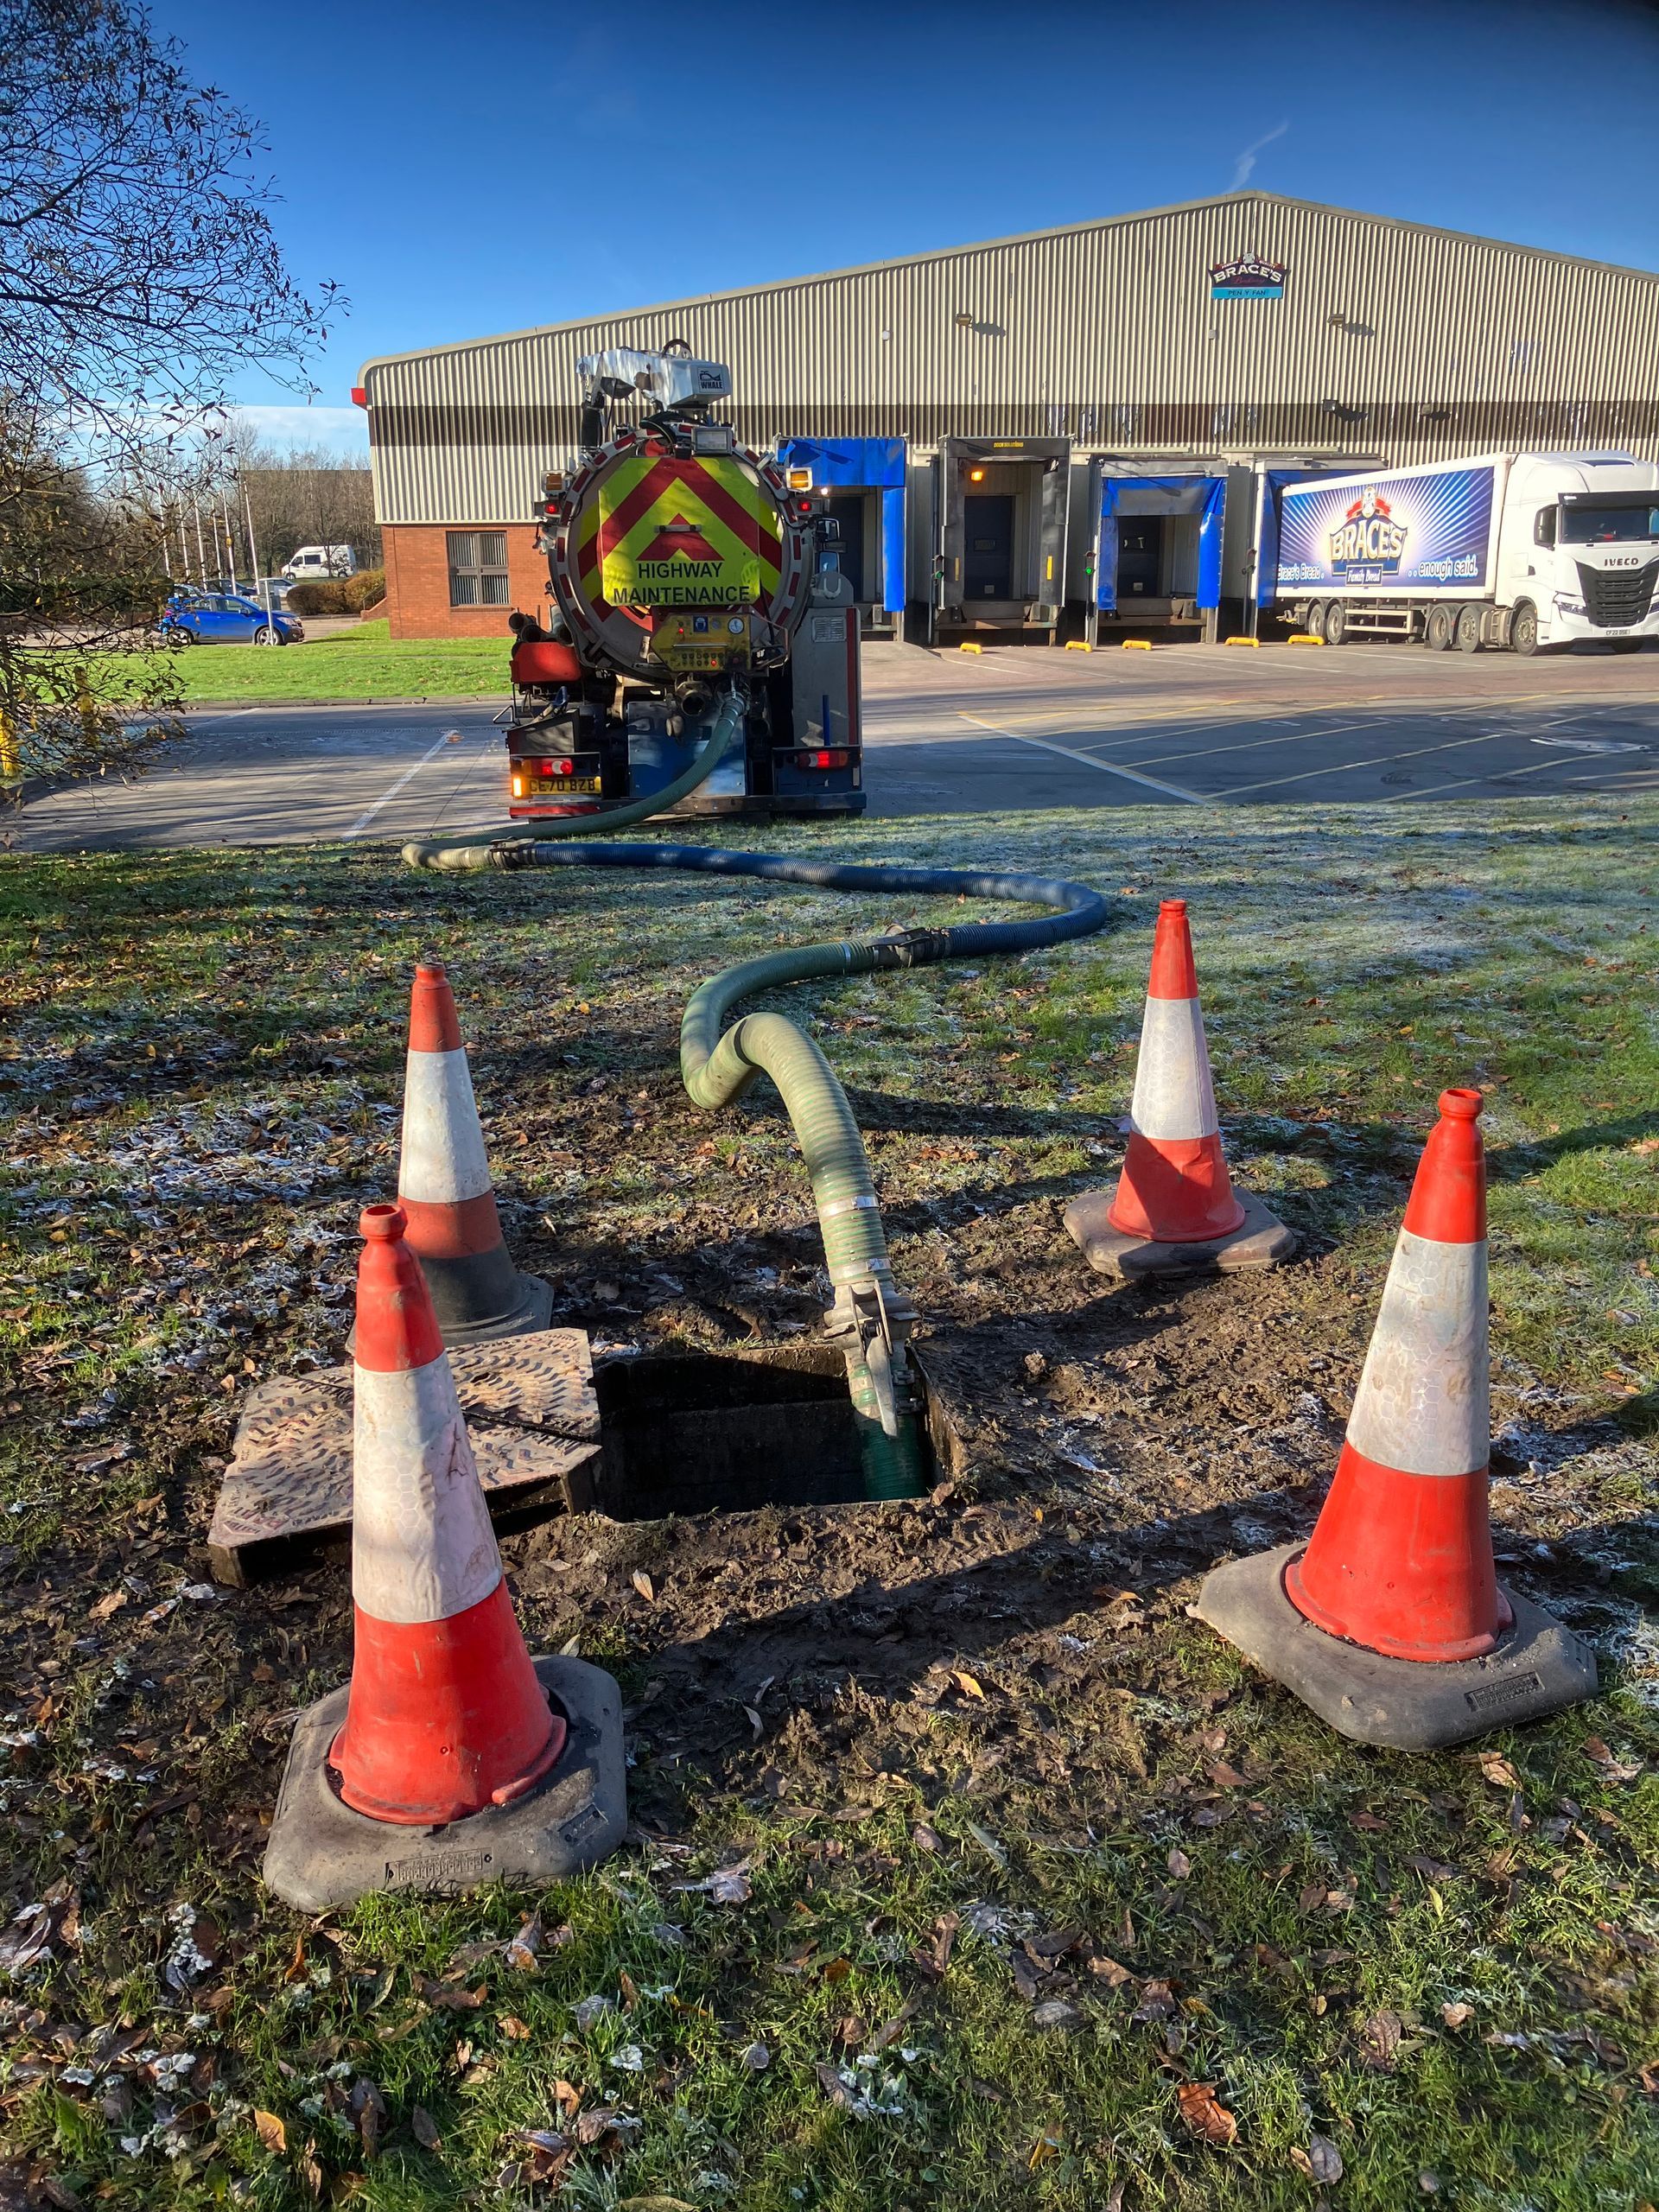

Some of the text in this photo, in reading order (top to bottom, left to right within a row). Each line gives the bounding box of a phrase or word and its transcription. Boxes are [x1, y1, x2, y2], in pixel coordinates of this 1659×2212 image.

[1213, 264, 1282, 283] BRACE'S
[1331, 519, 1404, 560] BRACE'S
[1604, 557, 1639, 566] IVECO
[638, 562, 722, 579] HIGHWAY
[1347, 569, 1381, 585] Family Bread
[613, 586, 750, 603] MAINTENANCE
